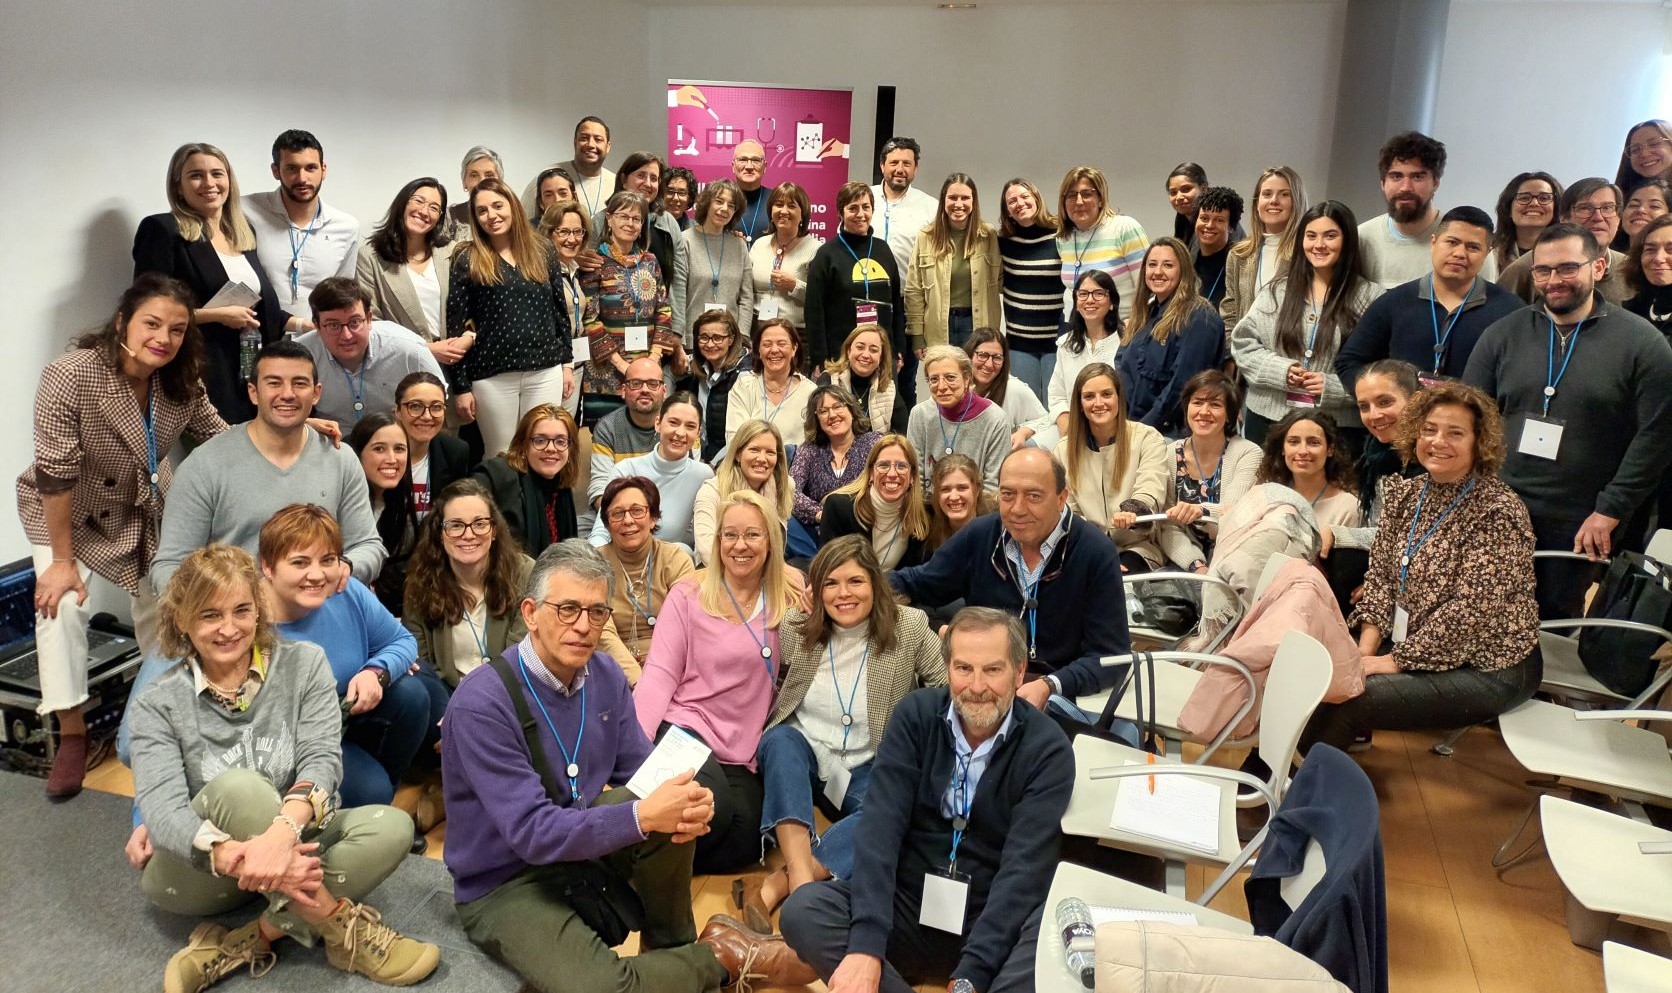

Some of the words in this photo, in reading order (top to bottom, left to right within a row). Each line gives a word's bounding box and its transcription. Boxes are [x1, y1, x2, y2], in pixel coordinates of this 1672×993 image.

[810, 204, 826, 213] no
[807, 219, 826, 230] ina
[807, 233, 827, 244] lia
